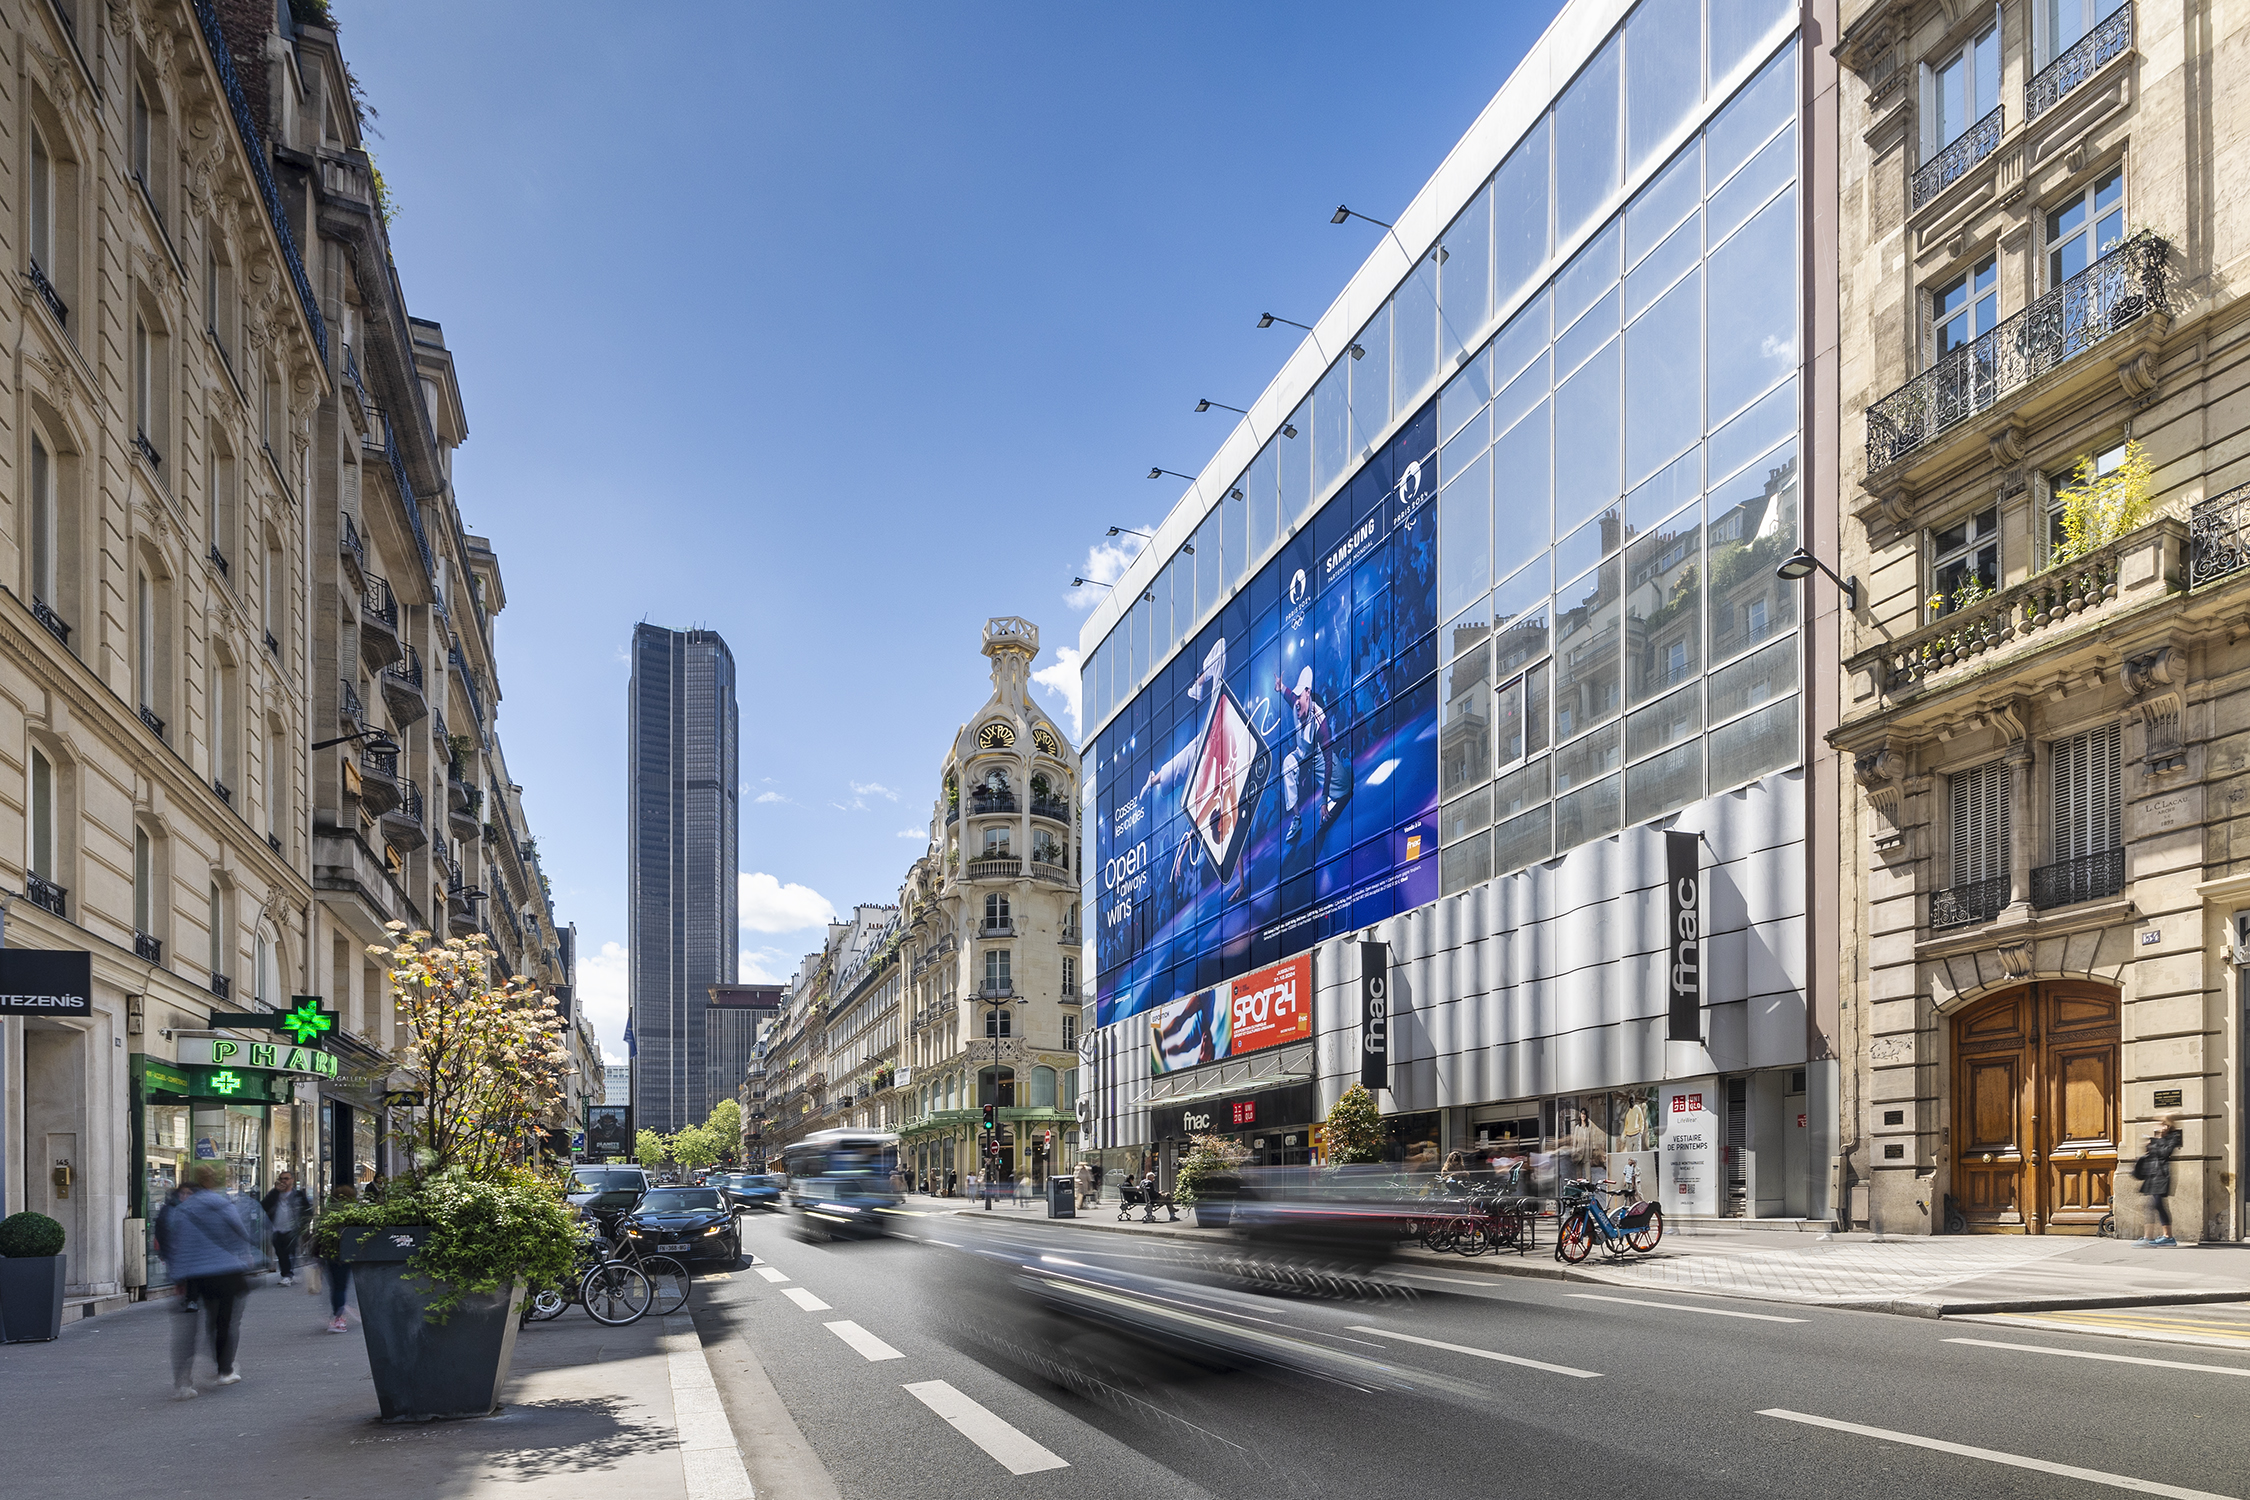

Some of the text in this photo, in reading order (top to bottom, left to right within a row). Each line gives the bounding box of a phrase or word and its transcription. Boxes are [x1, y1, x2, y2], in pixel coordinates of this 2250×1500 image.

[1326, 518, 1375, 573] SAMSUNG
[1353, 540, 1373, 560] MONDIAL
[1115, 796, 1138, 822] Cassez
[2162, 797, 2188, 808] LACAU
[1115, 806, 1145, 838] les codes
[1407, 838, 1421, 850] fnac
[1105, 841, 1147, 894] Open
[1120, 871, 1147, 897] always
[1107, 898, 1132, 927] wins
[1672, 876, 1698, 997] fnac
[2143, 931, 2160, 943] 134
[1365, 977, 1385, 1054] fnac
[1183, 1111, 1210, 1131] fnac
[1673, 1134, 1702, 1143] VESTIAIRE
[1676, 1142, 1708, 1150] PRINTEMPS
